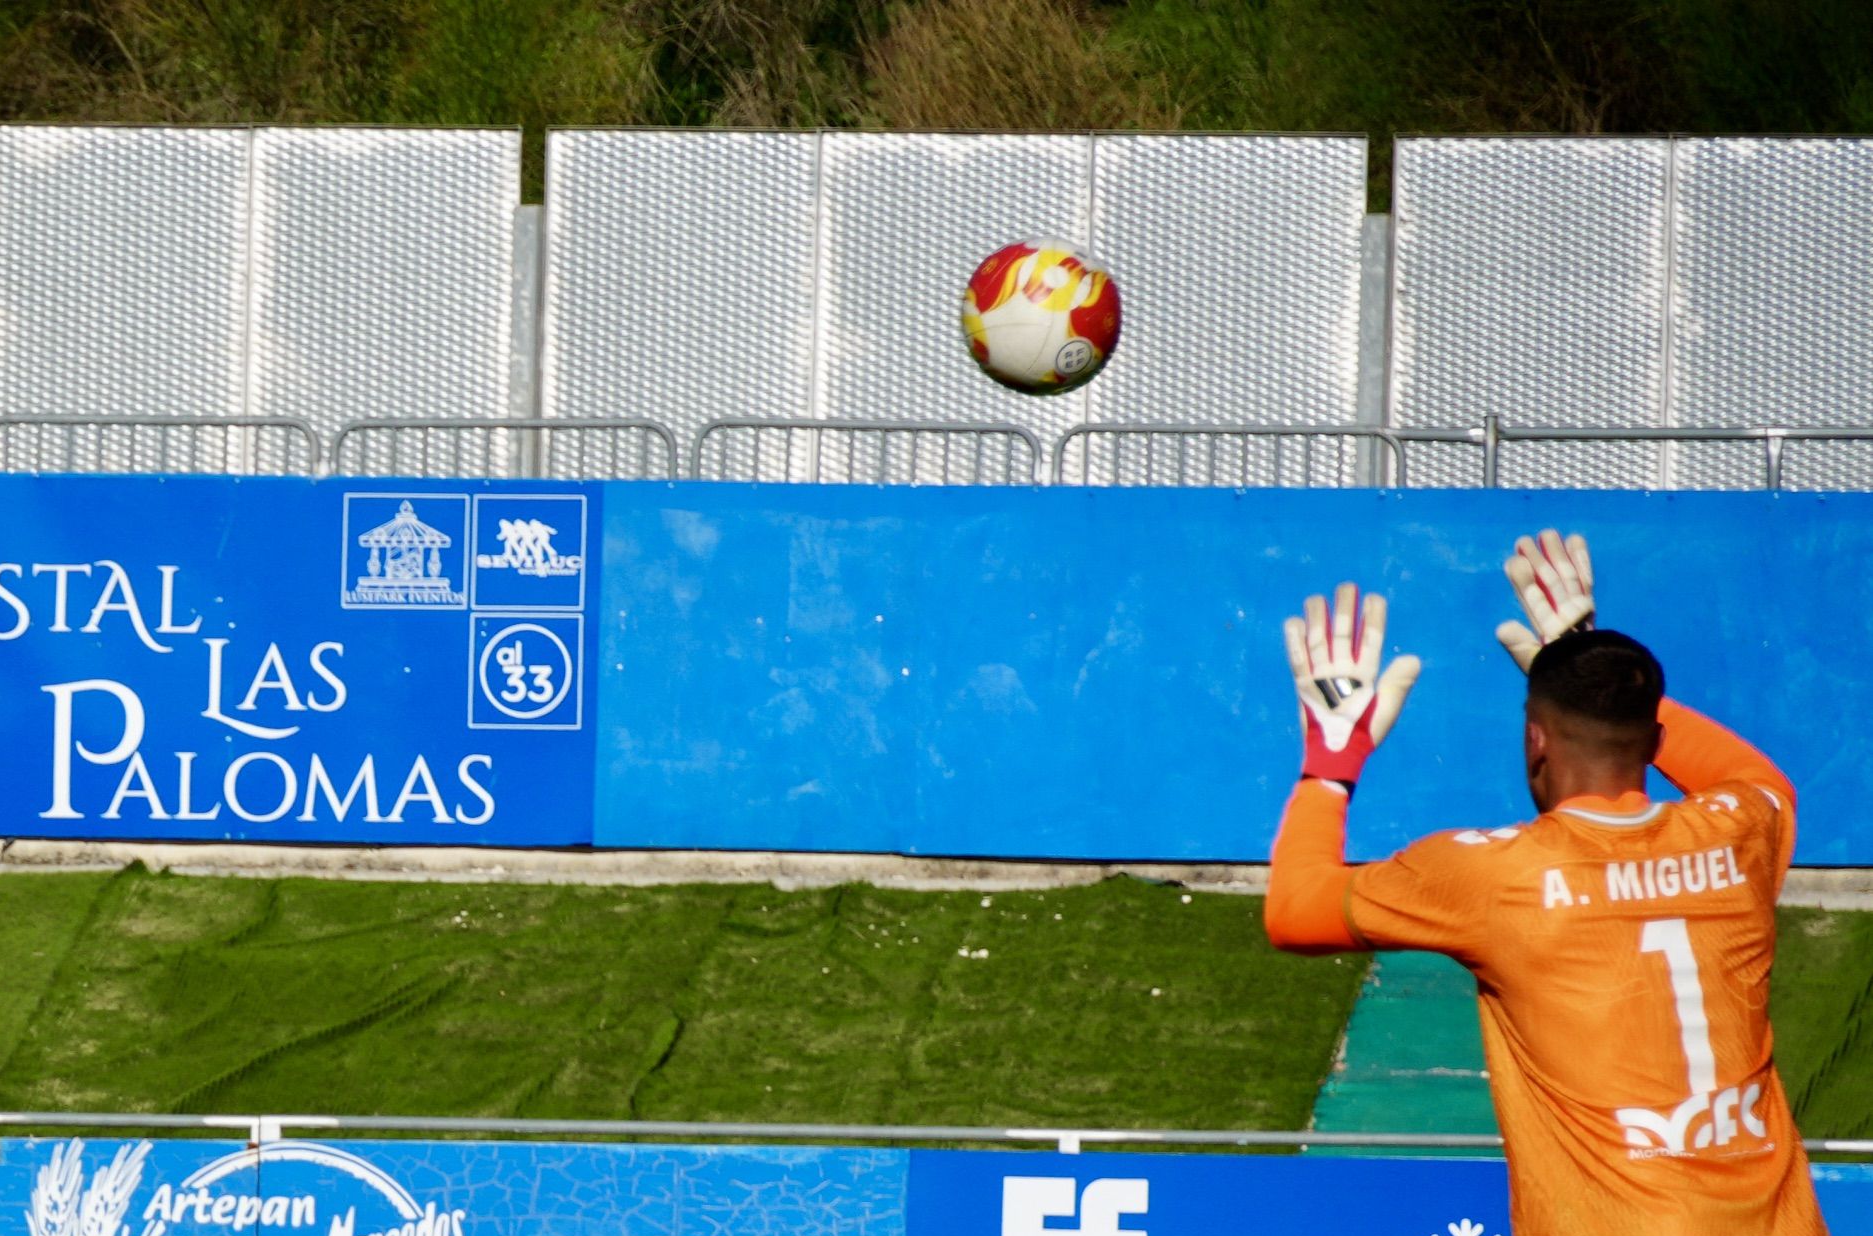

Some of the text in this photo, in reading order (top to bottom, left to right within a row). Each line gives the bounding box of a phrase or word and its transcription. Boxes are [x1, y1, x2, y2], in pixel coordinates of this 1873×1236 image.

[203, 638, 346, 739] LAS
[501, 664, 555, 704] 33
[39, 677, 496, 825] PALOMAS
[1543, 846, 1747, 909] A. MIGUEL
[1640, 918, 1718, 1095] 1
[143, 1183, 316, 1231] Artepan
